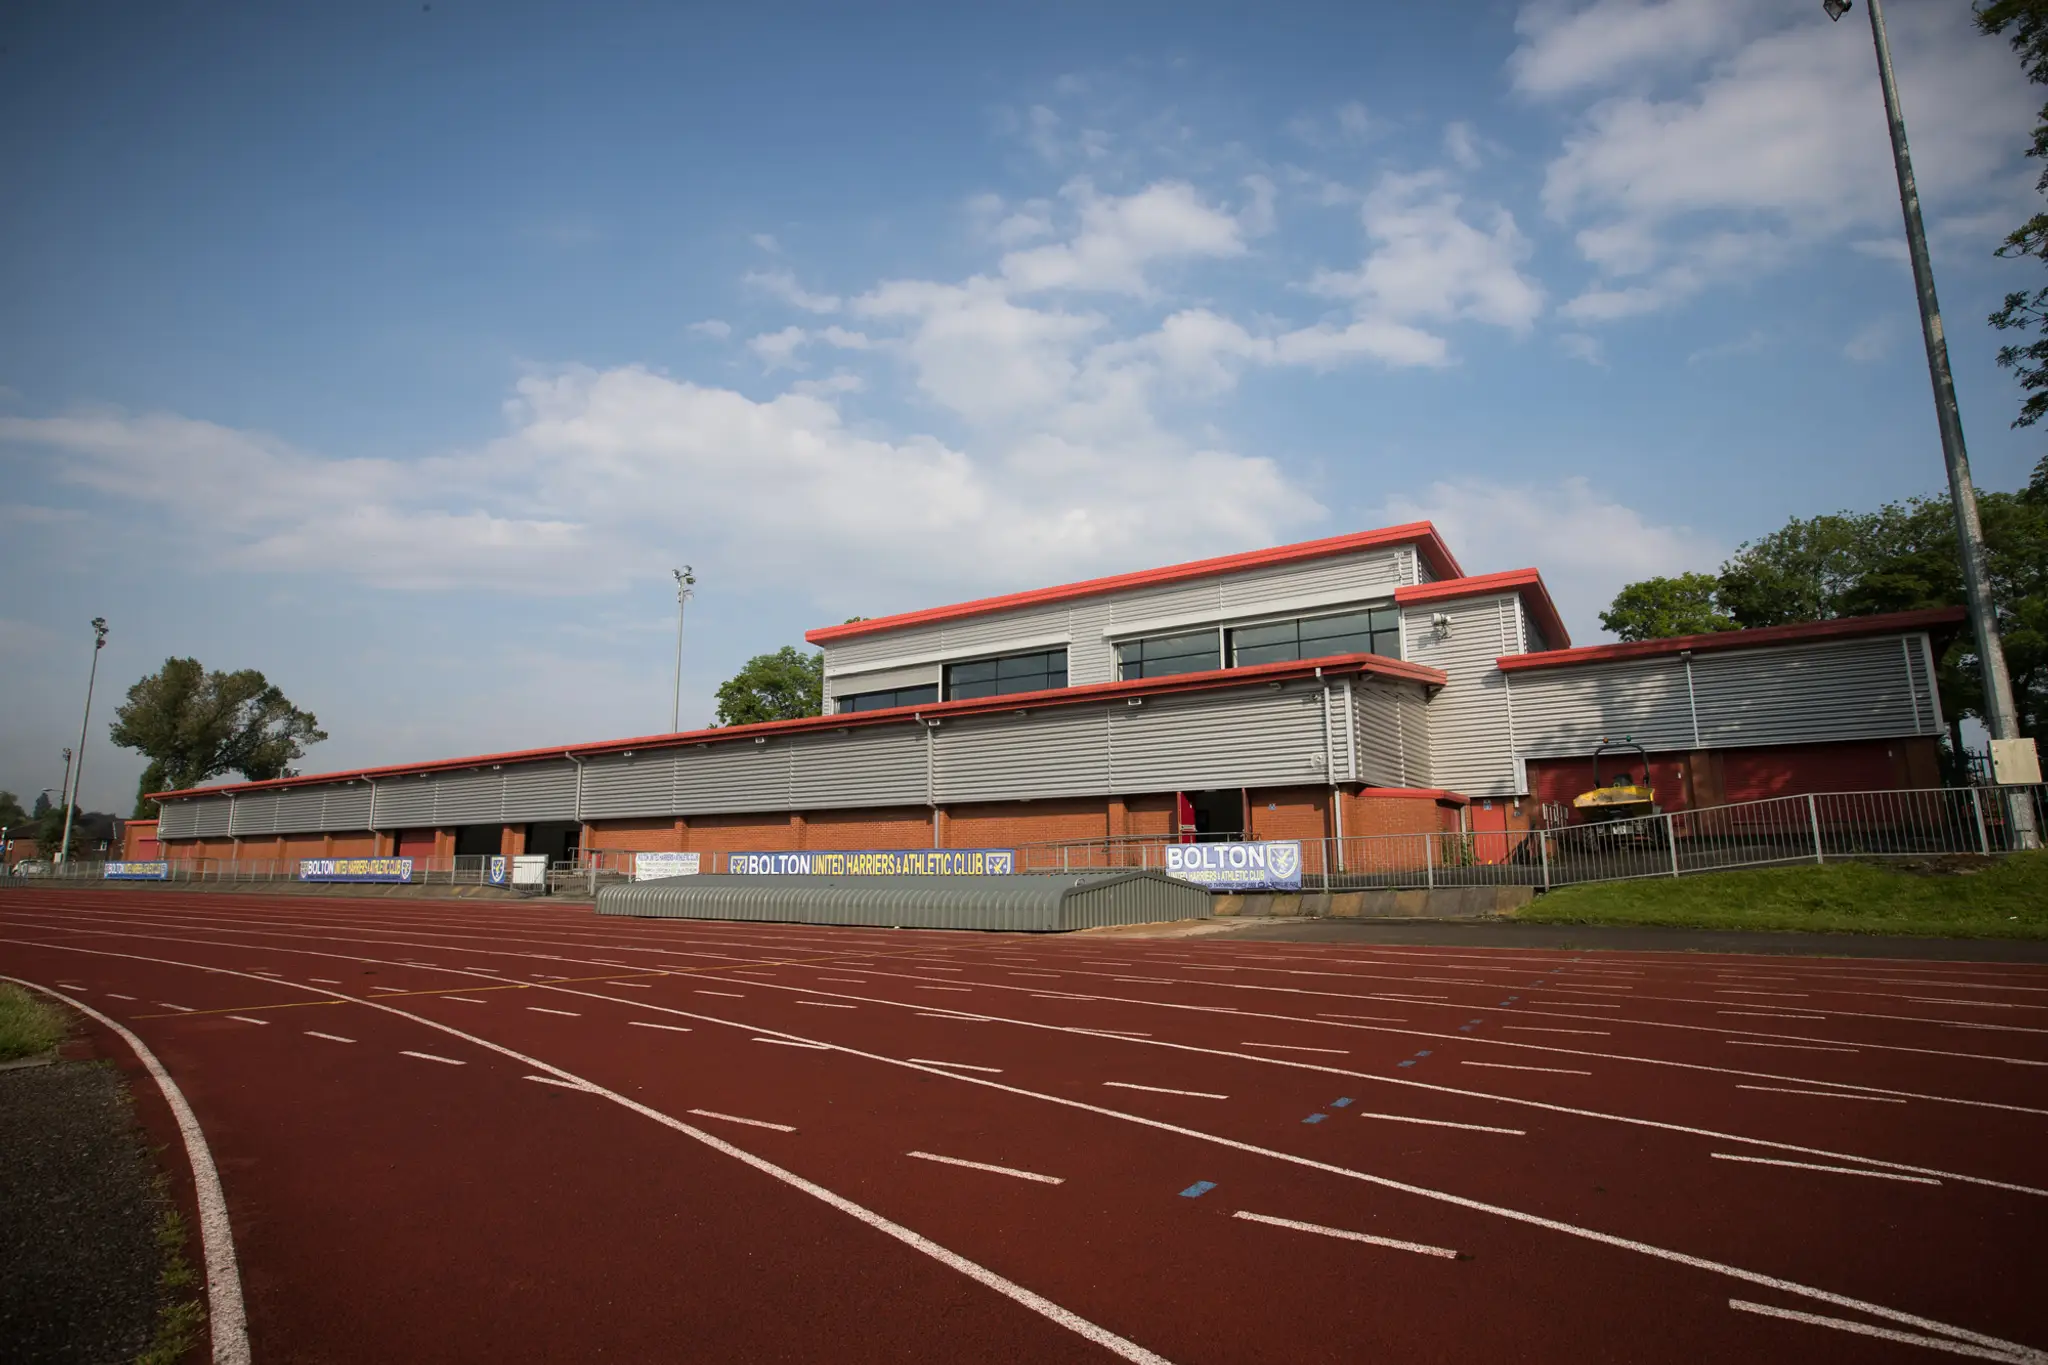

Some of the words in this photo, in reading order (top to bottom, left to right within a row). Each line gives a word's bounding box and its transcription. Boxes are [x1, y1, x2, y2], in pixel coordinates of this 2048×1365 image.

[748, 855, 811, 875] BOLTON
[811, 855, 844, 875] UNITED
[846, 854, 895, 875] HARRIERS
[896, 857, 902, 874] &
[902, 852, 952, 875] ATHLETIC
[953, 852, 983, 875] CLUB
[1167, 844, 1265, 870] BOLTON
[308, 860, 335, 875] BOLTON
[1167, 871, 1188, 880] UNITED
[1189, 870, 1217, 881] HARRIERS
[1221, 869, 1249, 880] ATHLETIC
[1249, 869, 1265, 880] CLUB
